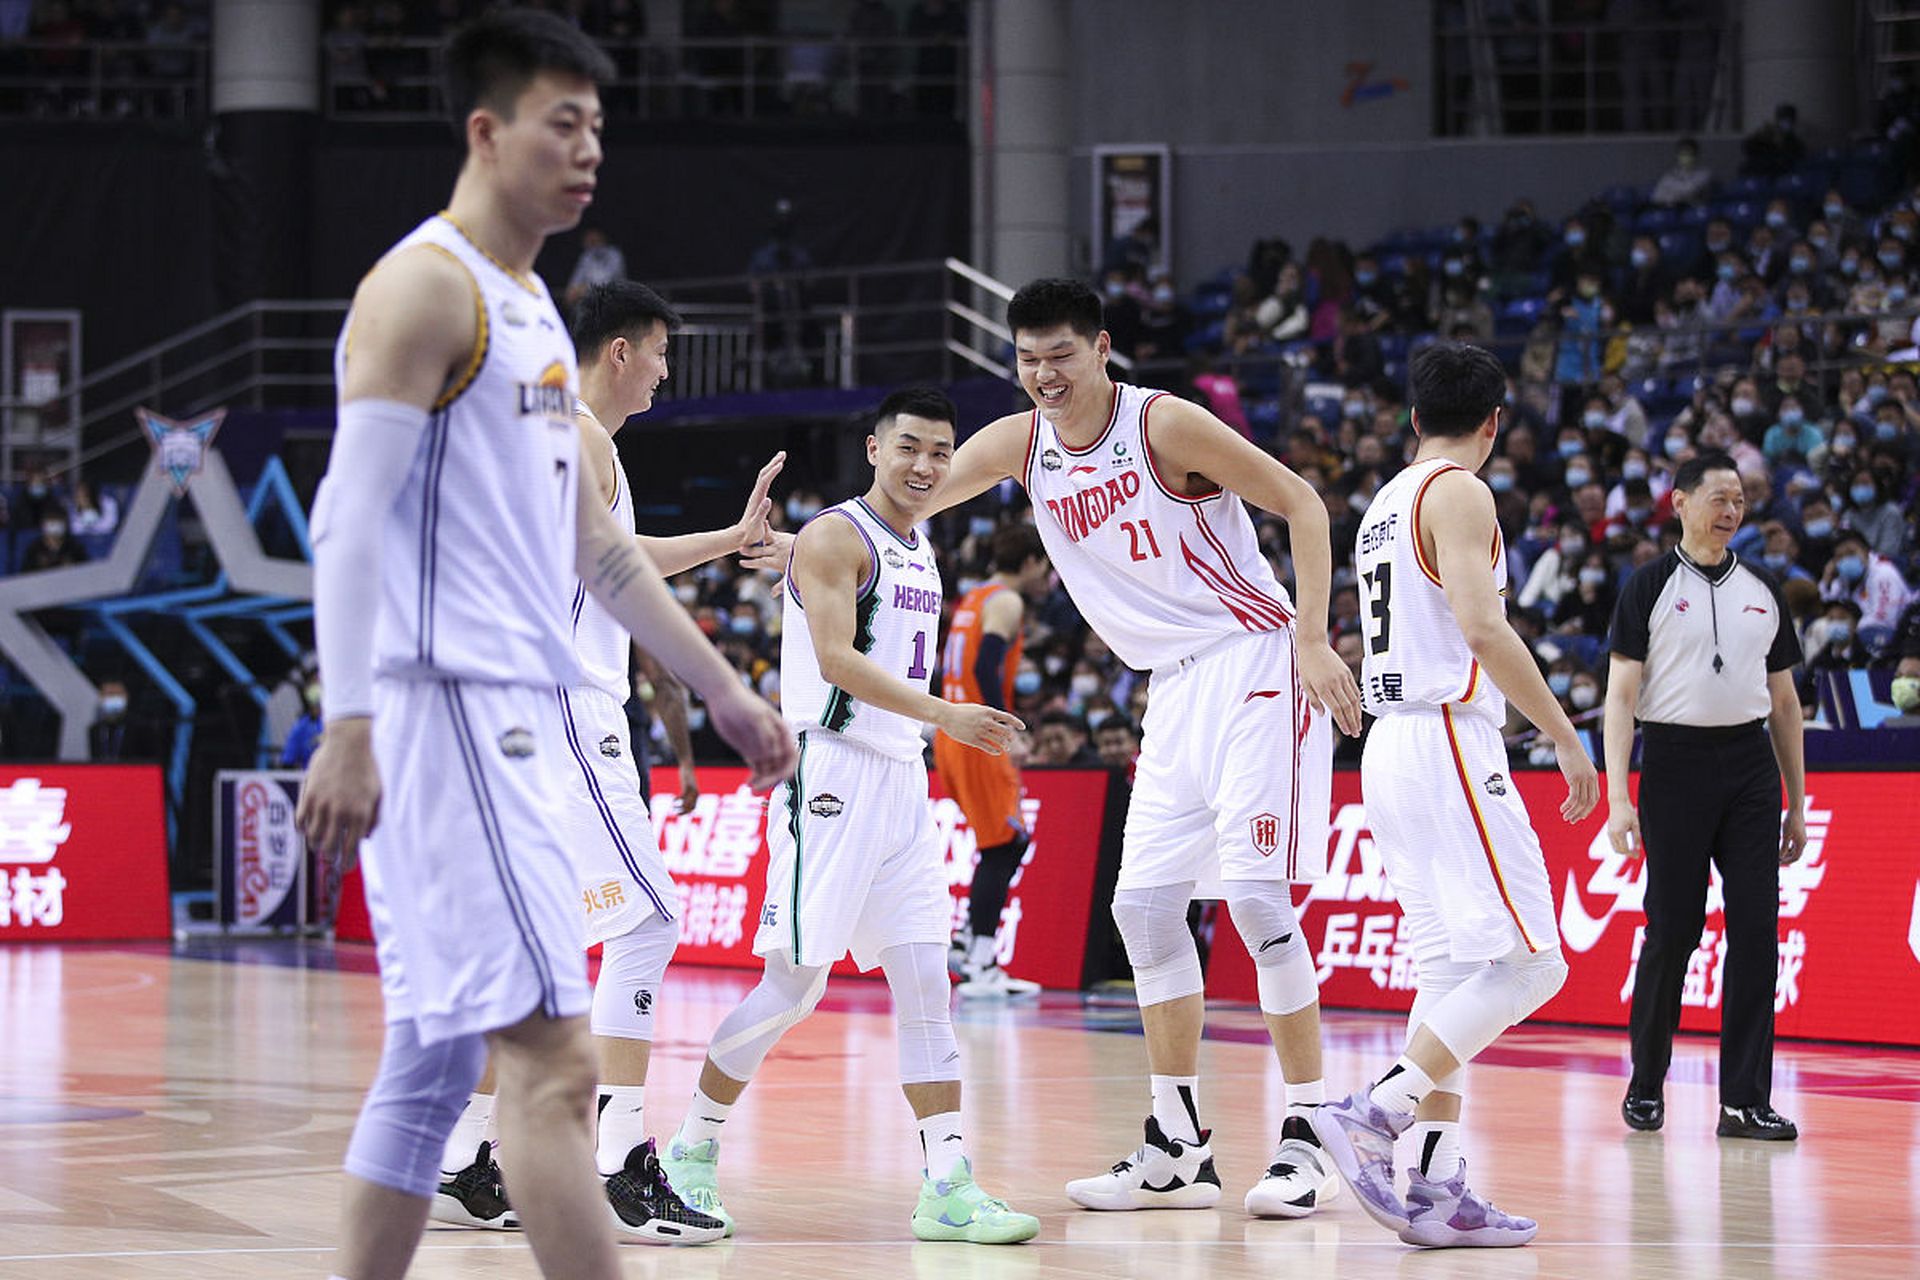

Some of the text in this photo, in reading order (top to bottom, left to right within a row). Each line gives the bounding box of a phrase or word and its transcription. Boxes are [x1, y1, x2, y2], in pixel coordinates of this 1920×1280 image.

[554, 457, 569, 506] 7
[1120, 519, 1162, 562] 21
[907, 630, 928, 680] 1
[0, 867, 67, 927] 材
[583, 880, 625, 914] 北京
